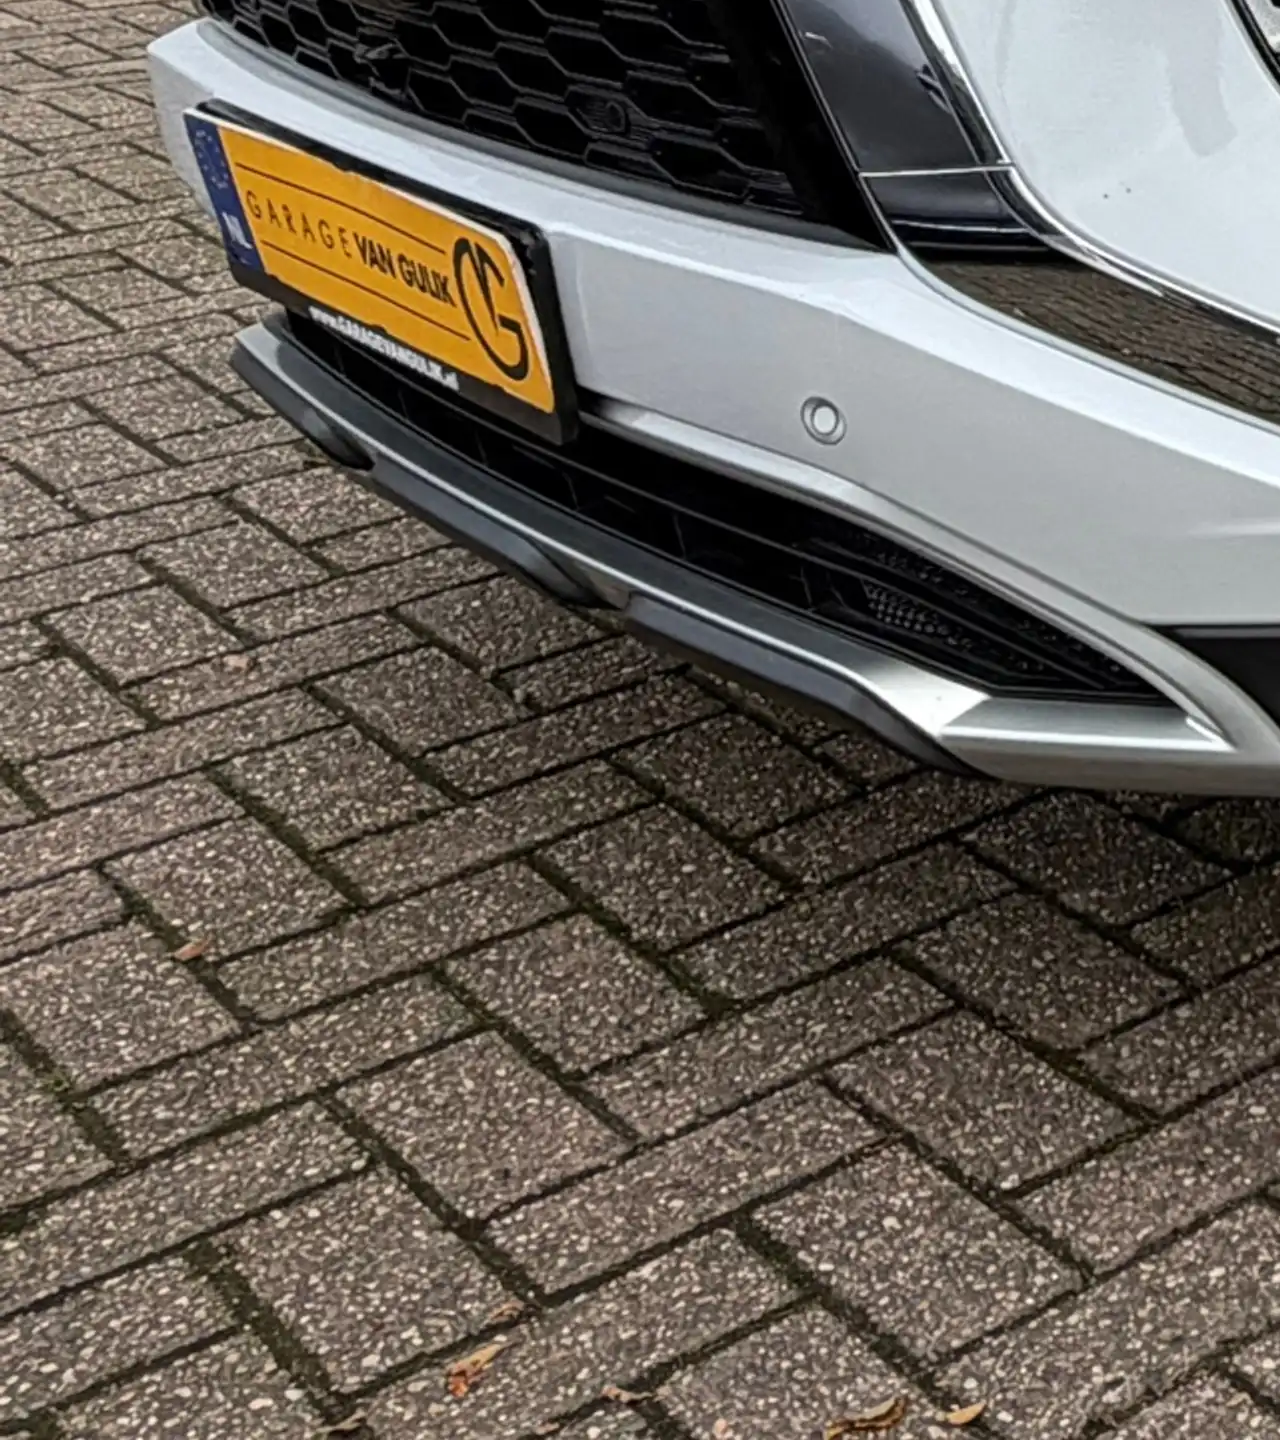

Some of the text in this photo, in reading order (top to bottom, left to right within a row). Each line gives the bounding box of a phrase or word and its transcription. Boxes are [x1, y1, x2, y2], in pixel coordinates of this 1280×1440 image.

[221, 211, 254, 251] NL
[245, 189, 352, 259] GARAGE
[352, 231, 397, 279] VAN
